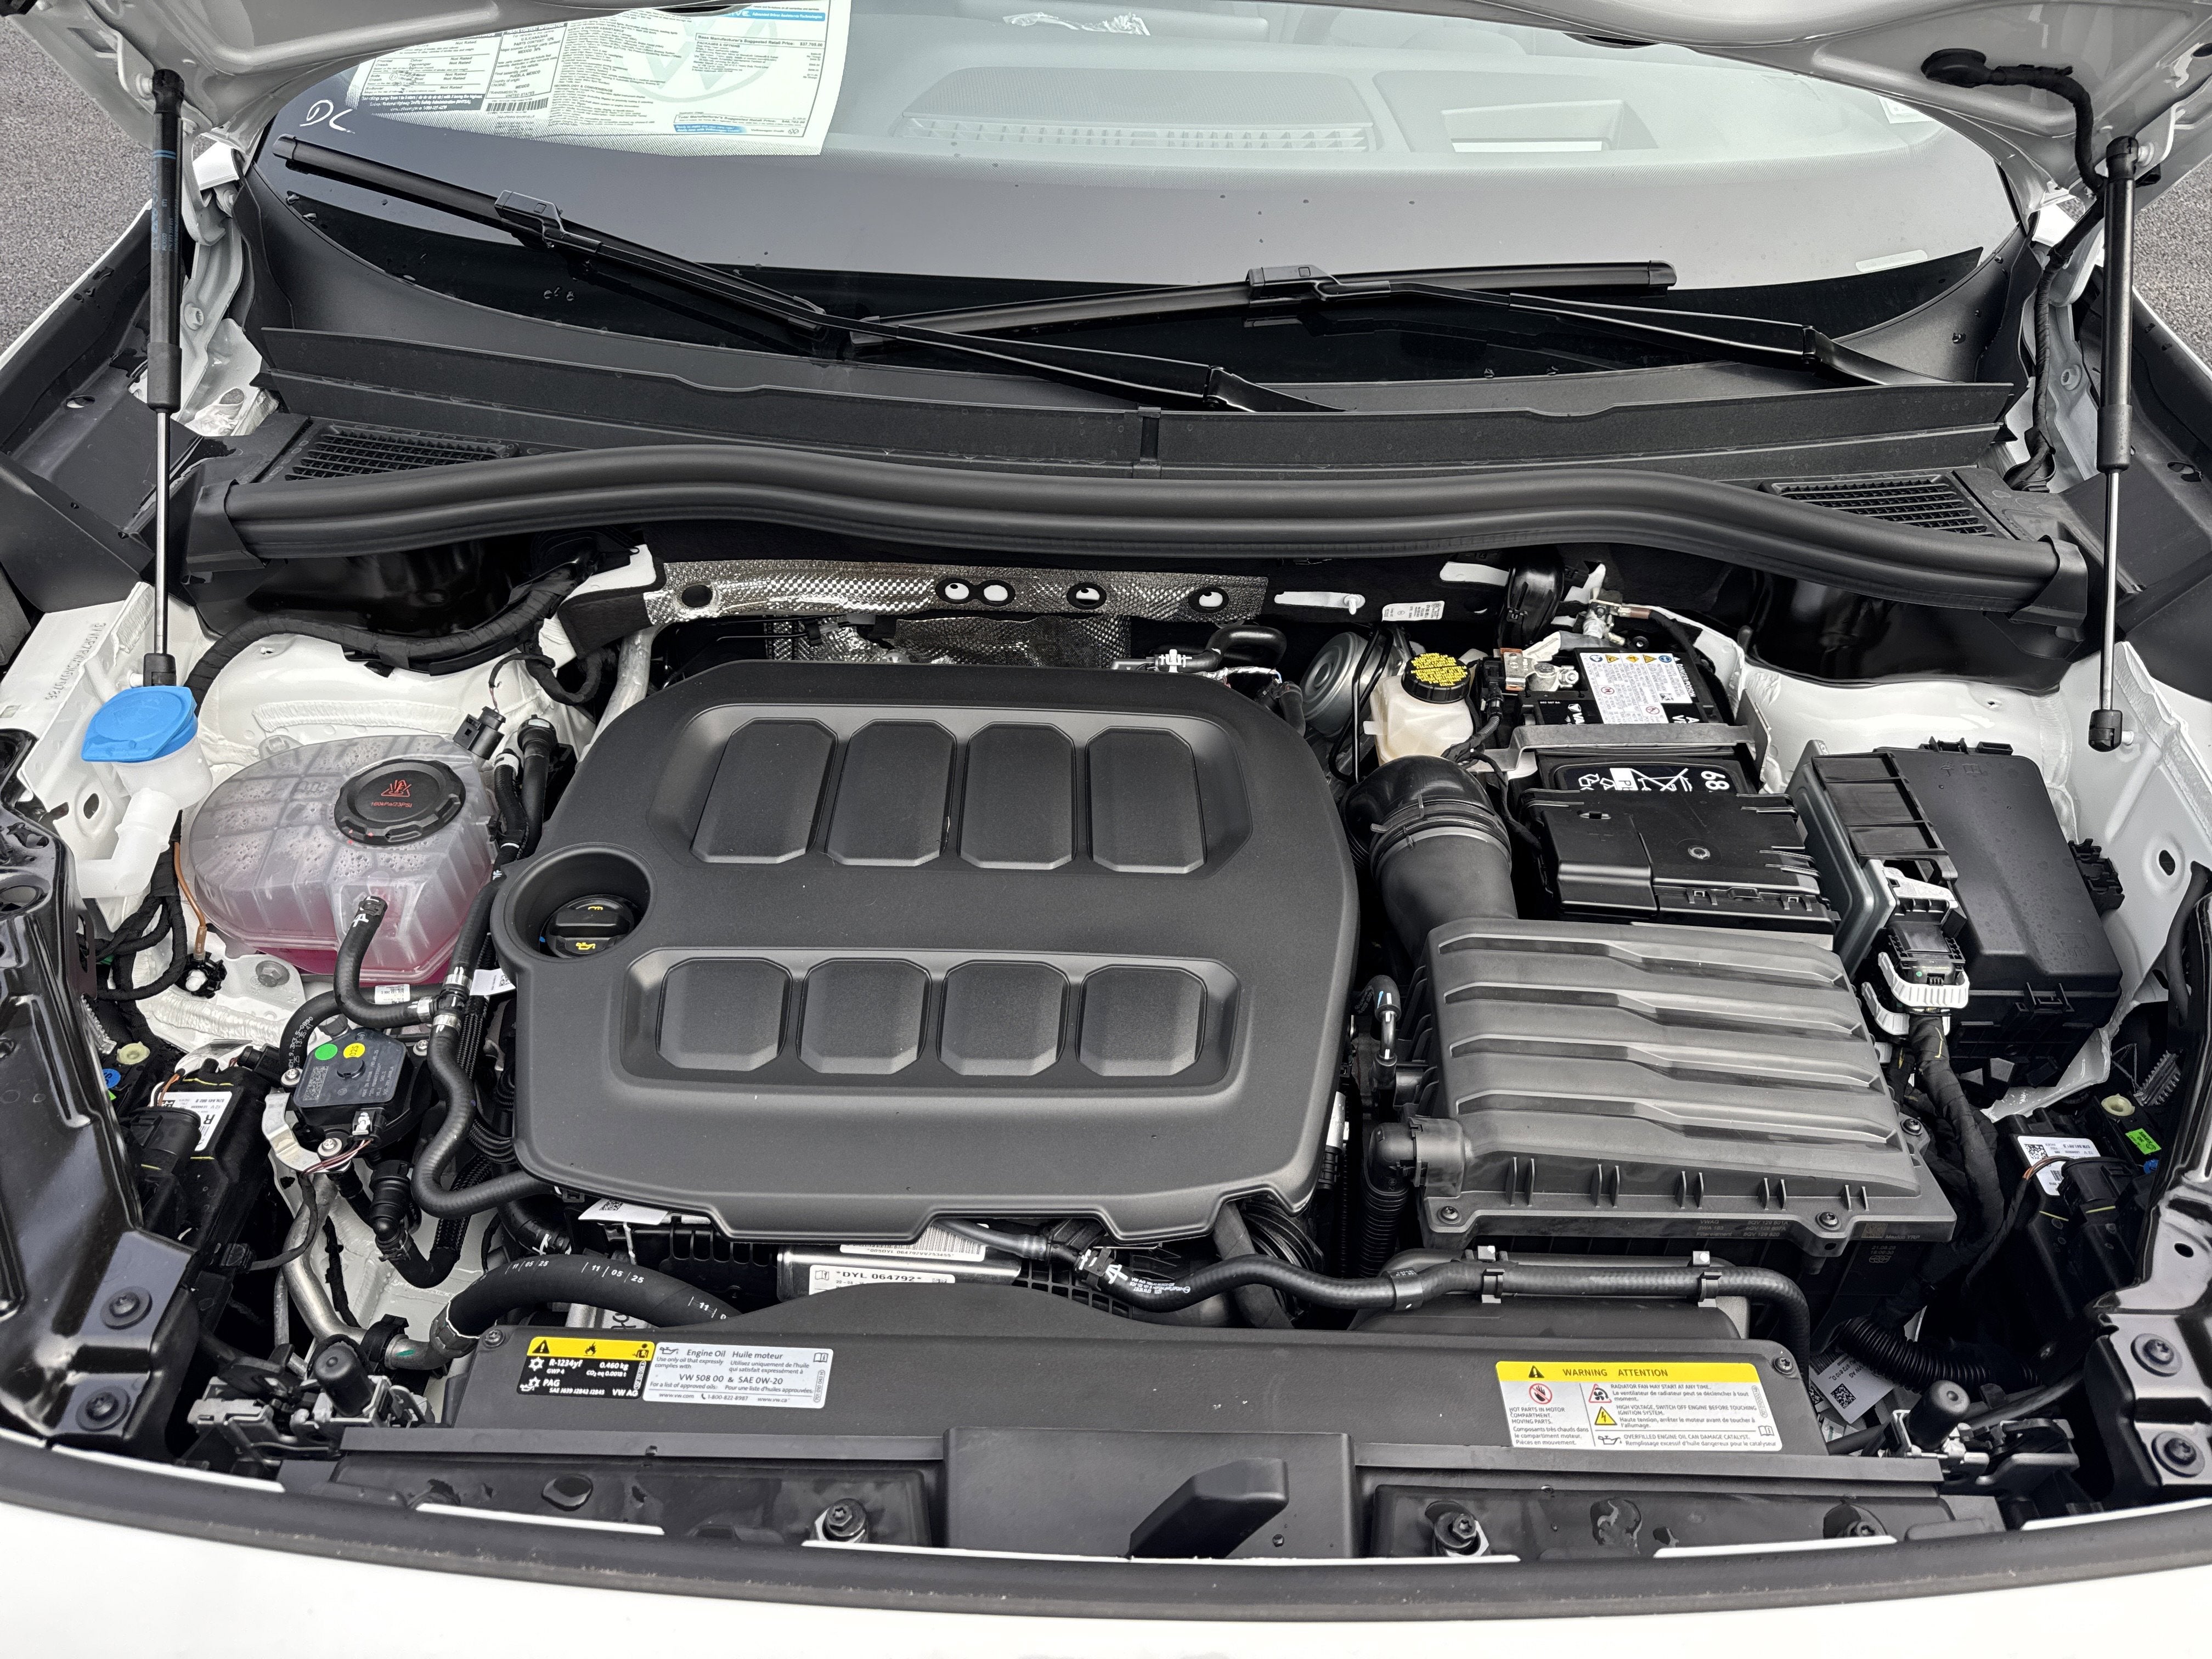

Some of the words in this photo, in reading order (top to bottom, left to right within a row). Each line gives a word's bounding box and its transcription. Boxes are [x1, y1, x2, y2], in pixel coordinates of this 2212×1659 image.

[203, 1114, 216, 1125] R
[687, 1349, 713, 1358] Engine
[549, 1359, 583, 1369] R-1234yf
